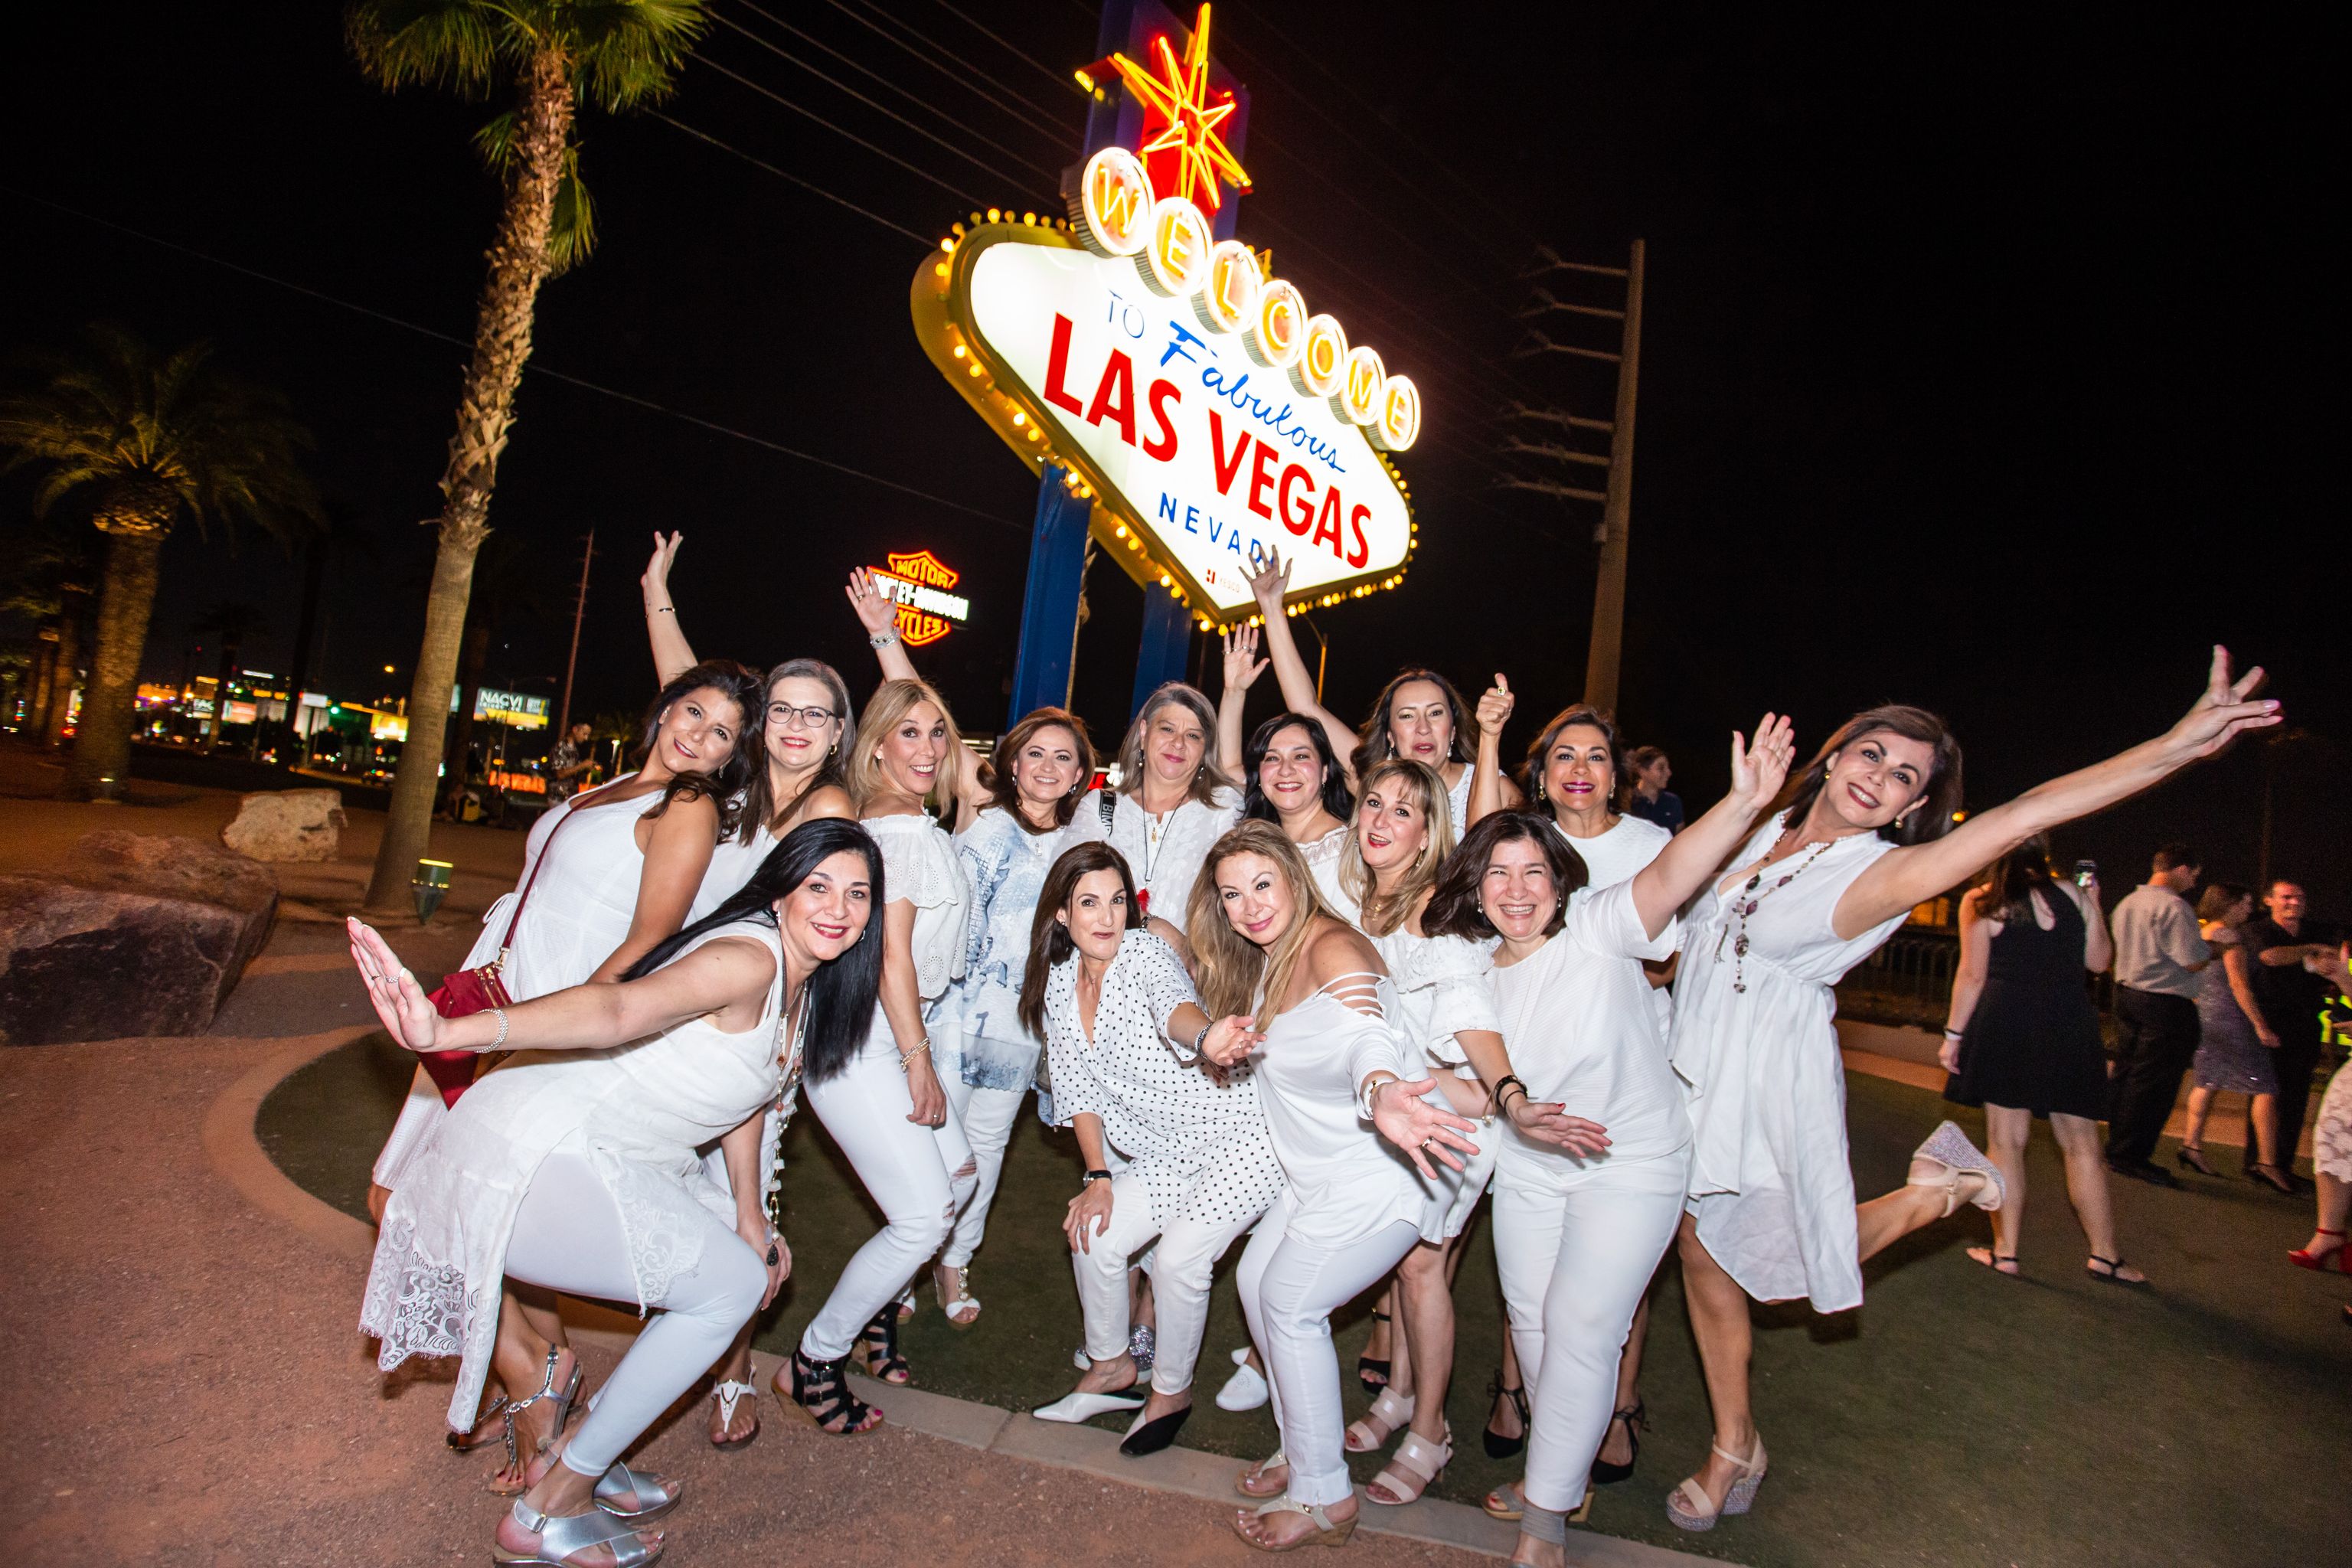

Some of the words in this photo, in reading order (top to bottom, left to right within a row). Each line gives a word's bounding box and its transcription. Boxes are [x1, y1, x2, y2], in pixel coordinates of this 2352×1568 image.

[1095, 159, 1410, 439] WELCOME
[1109, 289, 1145, 338] TO
[1160, 319, 1347, 473] Fabulous
[1043, 311, 1182, 462] LAS
[1208, 407, 1372, 570] VEGAS
[1158, 492, 1277, 570] NEVAD
[895, 556, 949, 589] MOTOR
[893, 609, 943, 641] YCLES
